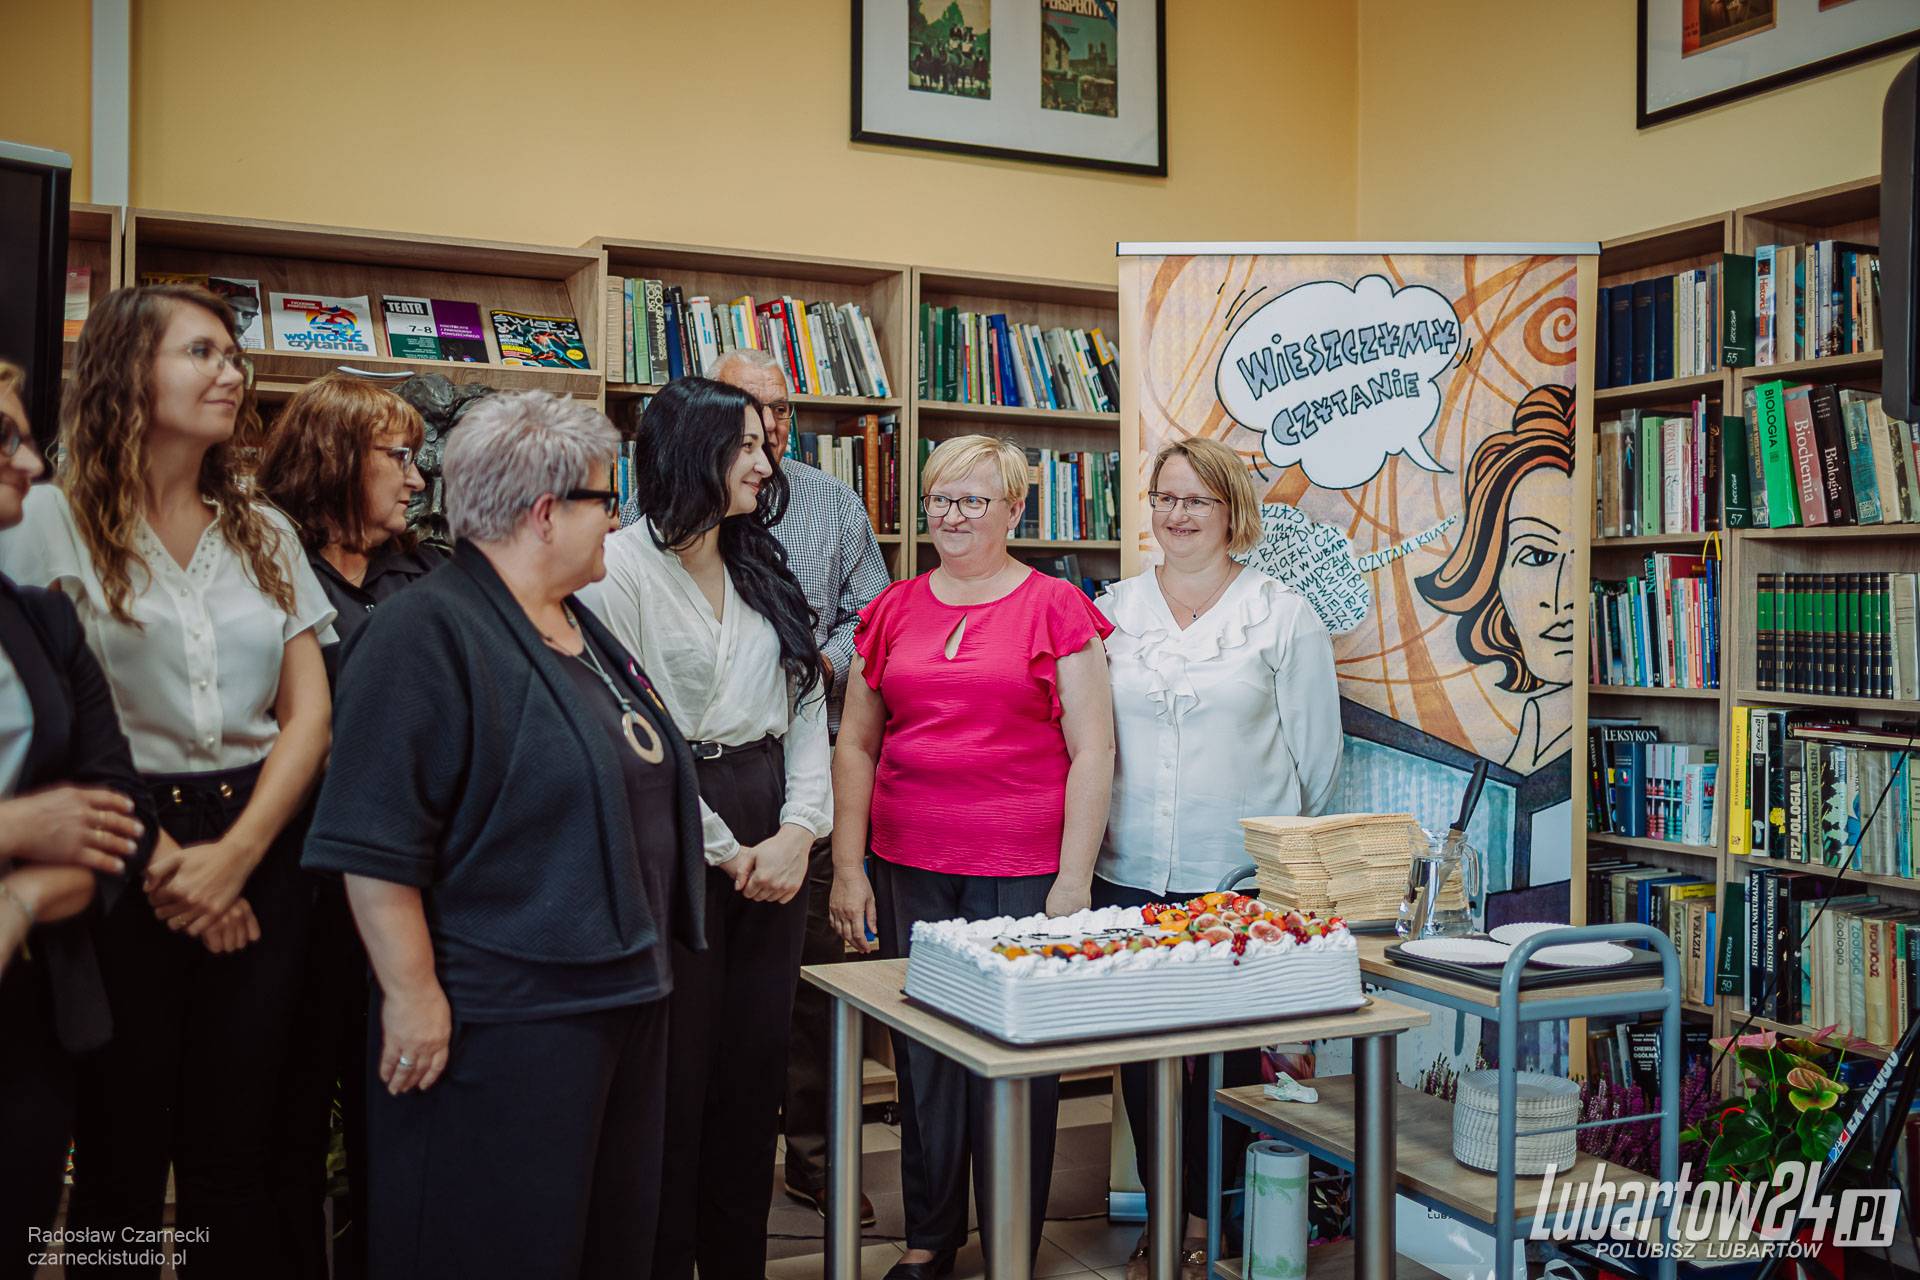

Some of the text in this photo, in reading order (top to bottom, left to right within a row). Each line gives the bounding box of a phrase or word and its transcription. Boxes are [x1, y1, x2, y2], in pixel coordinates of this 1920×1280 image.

[386, 302, 424, 314] TEATR
[288, 340, 369, 352] czytania
[1725, 351, 1738, 365] 55
[1763, 388, 1776, 448] BIOLOGIA
[1793, 417, 1815, 504] Biochemia
[1824, 446, 1841, 501] Biologia
[1730, 512, 1743, 527] 57
[1604, 729, 1659, 743] LEKSYKON
[1790, 782, 1802, 860] FIZJOLOGIA
[1810, 748, 1820, 846] ANATOMIA ROŚLIN
[1692, 915, 1702, 960] FIZYKA
[1751, 873, 1760, 967] HISTORIA NATURALNA
[1766, 878, 1775, 973] HISTORIA NATURALNA
